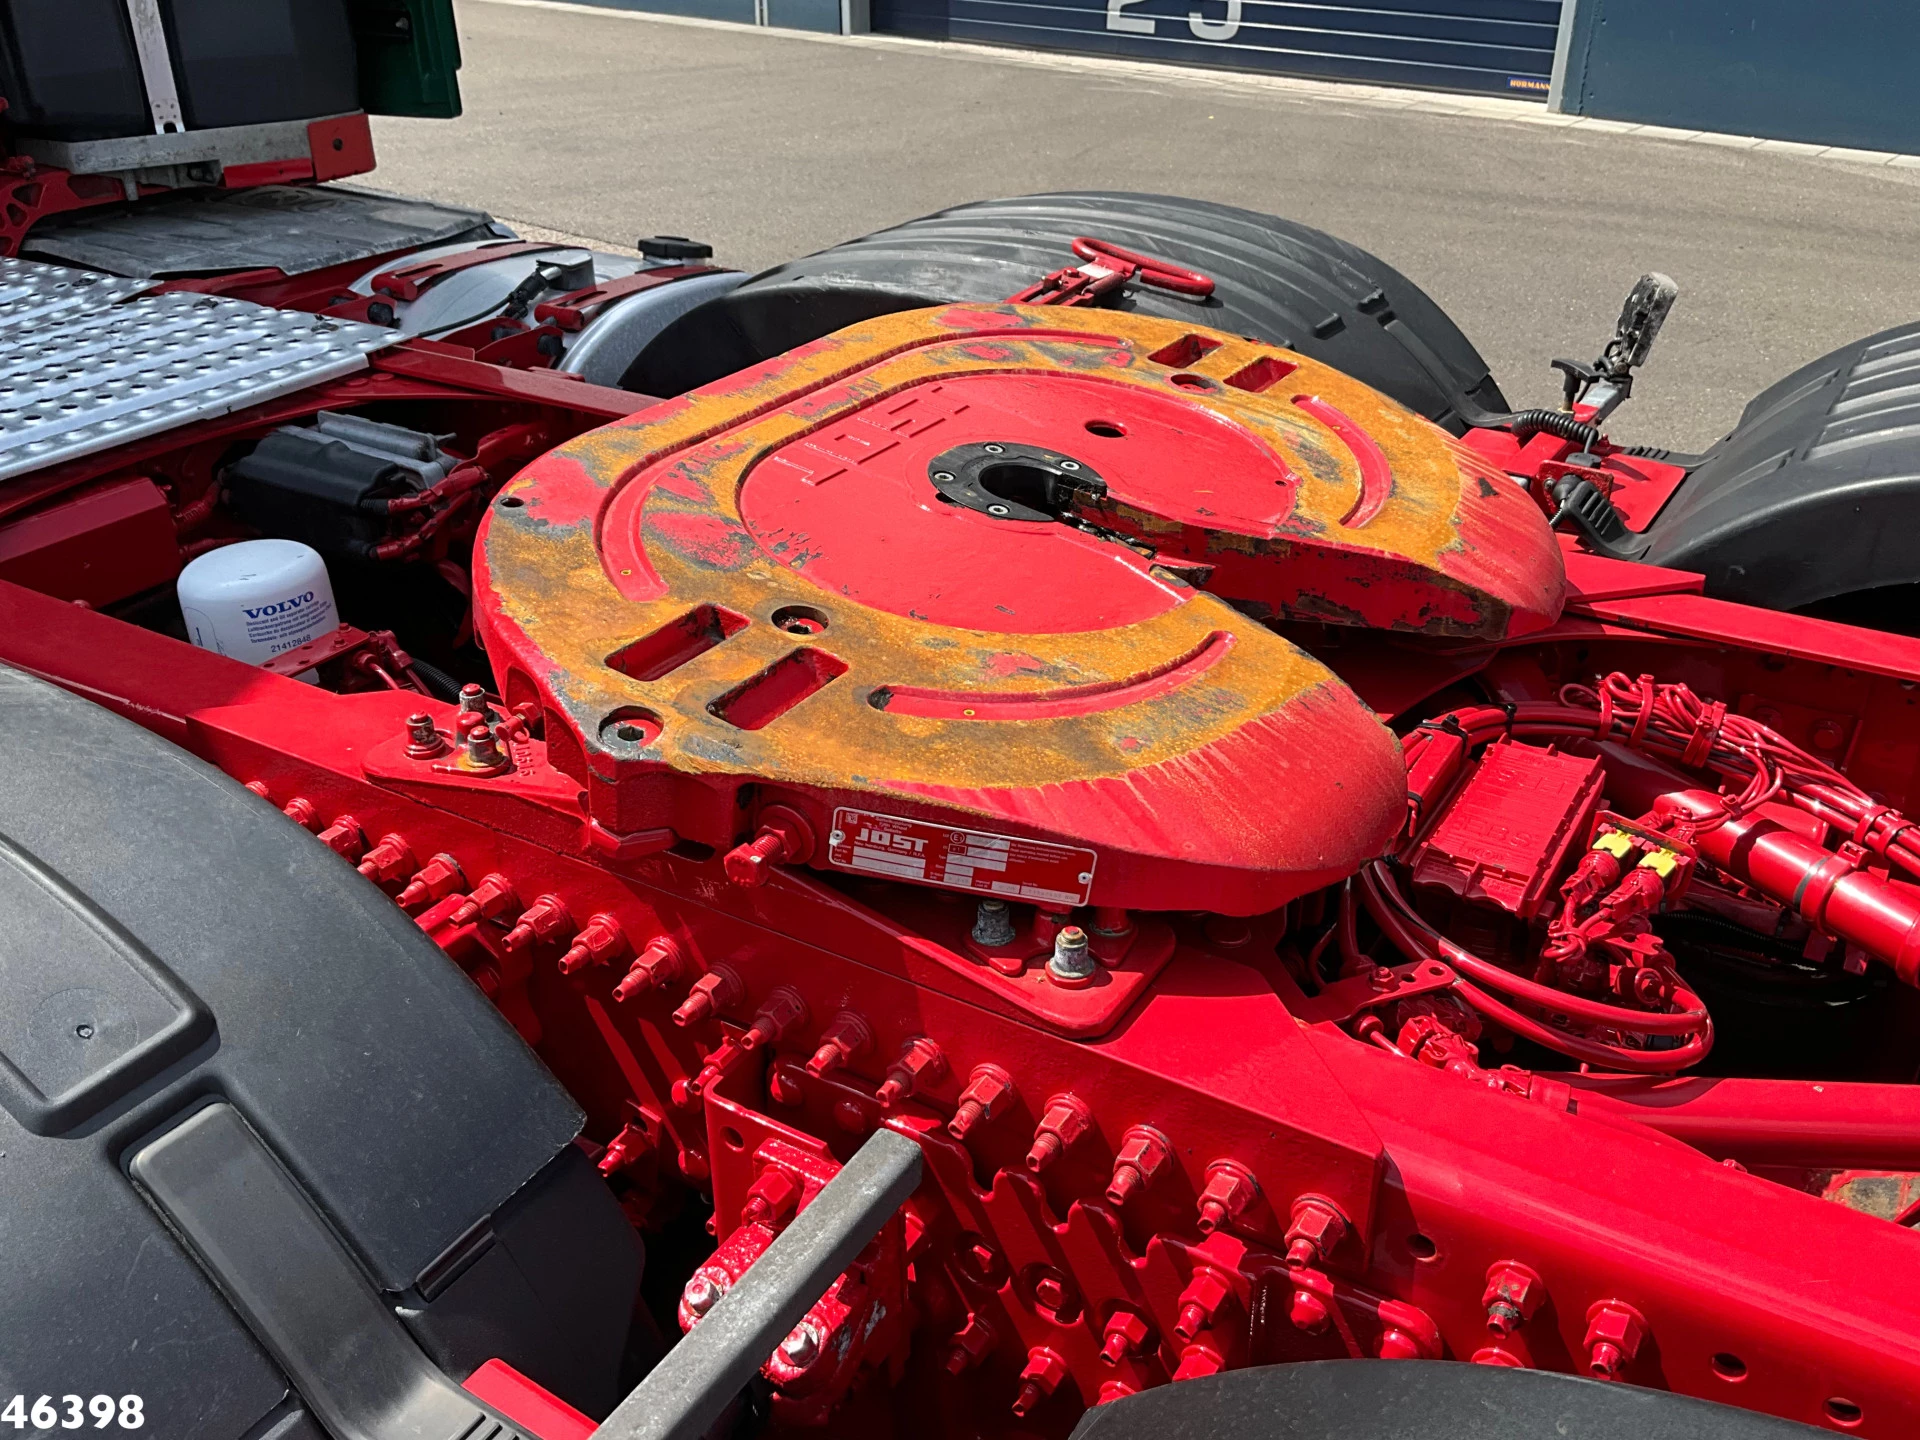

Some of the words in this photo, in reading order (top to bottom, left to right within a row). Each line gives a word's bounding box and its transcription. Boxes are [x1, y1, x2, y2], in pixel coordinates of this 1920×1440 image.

[242, 591, 314, 619] VOLVO
[270, 634, 312, 653] 21412848
[855, 828, 929, 852] JOST
